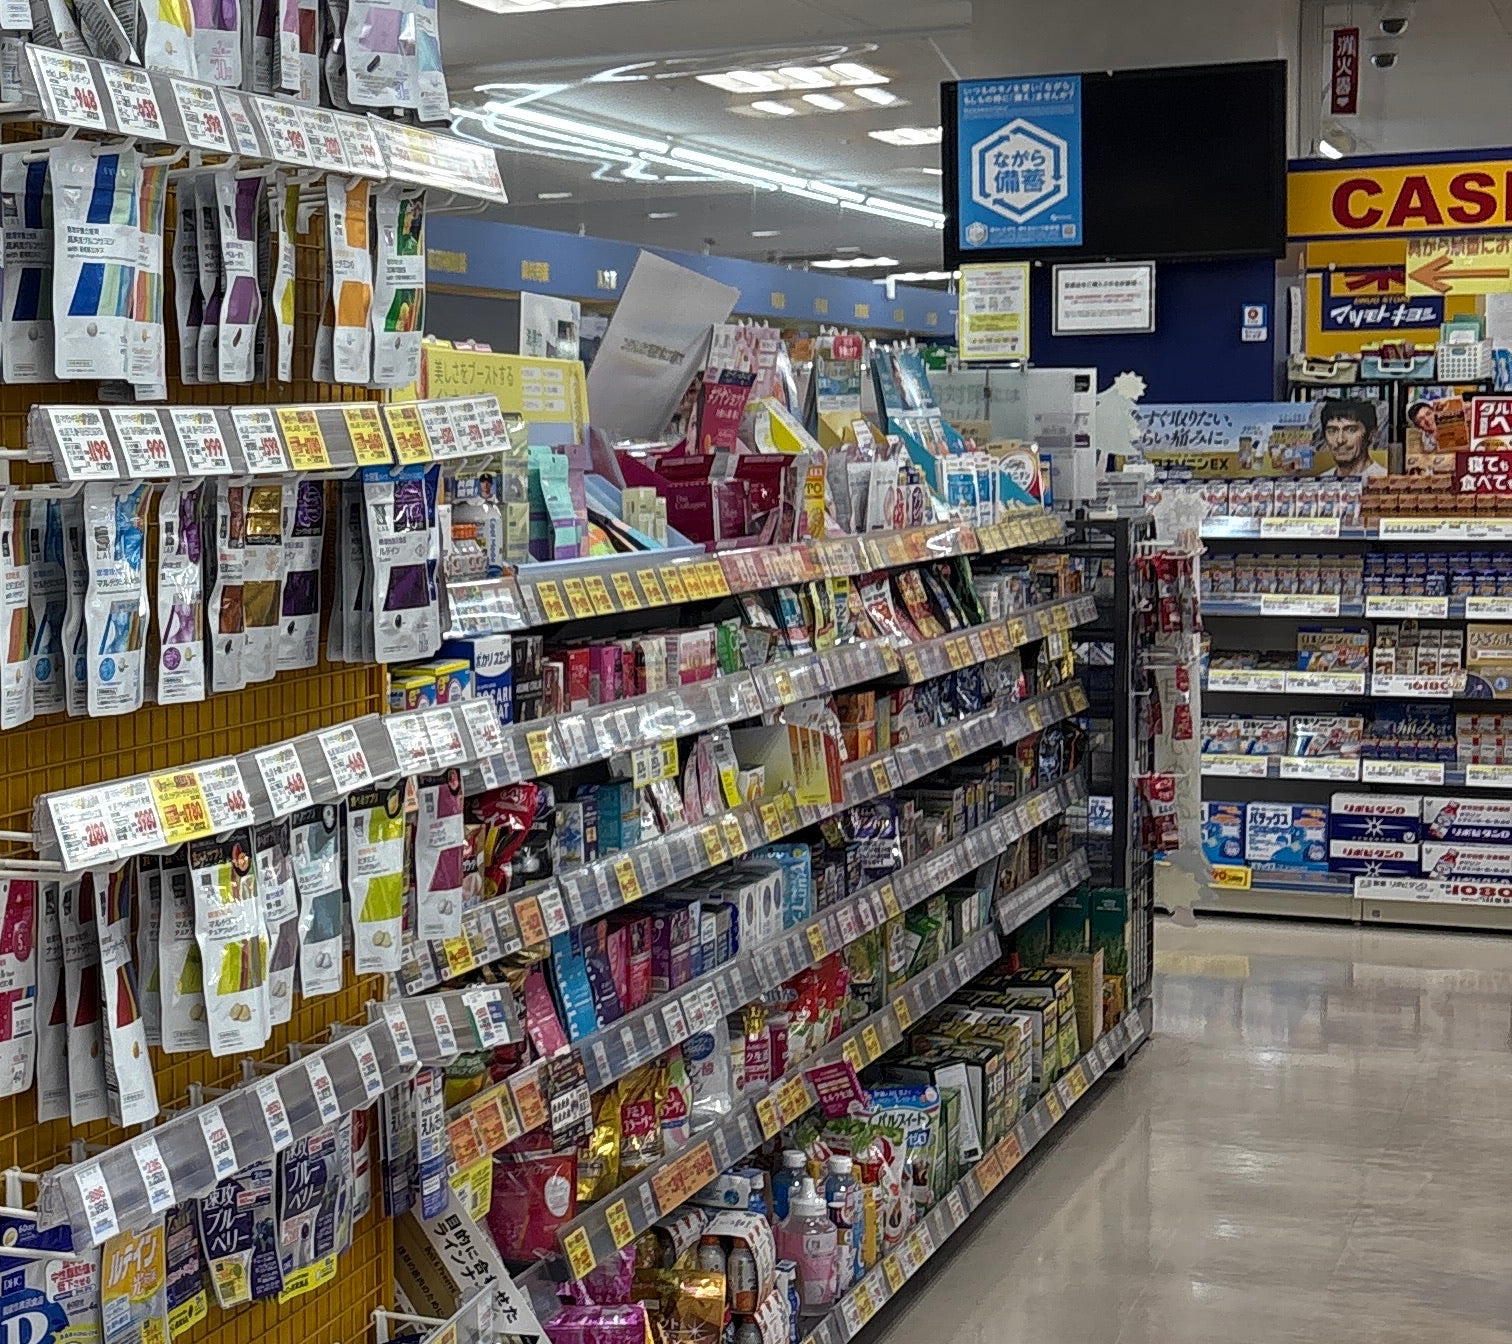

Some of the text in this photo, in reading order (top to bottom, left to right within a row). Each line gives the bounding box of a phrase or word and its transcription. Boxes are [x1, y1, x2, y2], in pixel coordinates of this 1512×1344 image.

[993, 150, 1046, 170] ながら
[994, 169, 1046, 194] 備蓄
[1332, 171, 1512, 229] CAS
[289, 1159, 322, 1190] ブルー
[289, 1187, 322, 1209] ベリー
[206, 1209, 247, 1235] ブルー
[210, 1232, 250, 1253] ベリー
[109, 1235, 156, 1287] ルテイン
[3, 1277, 22, 1290] DHC
